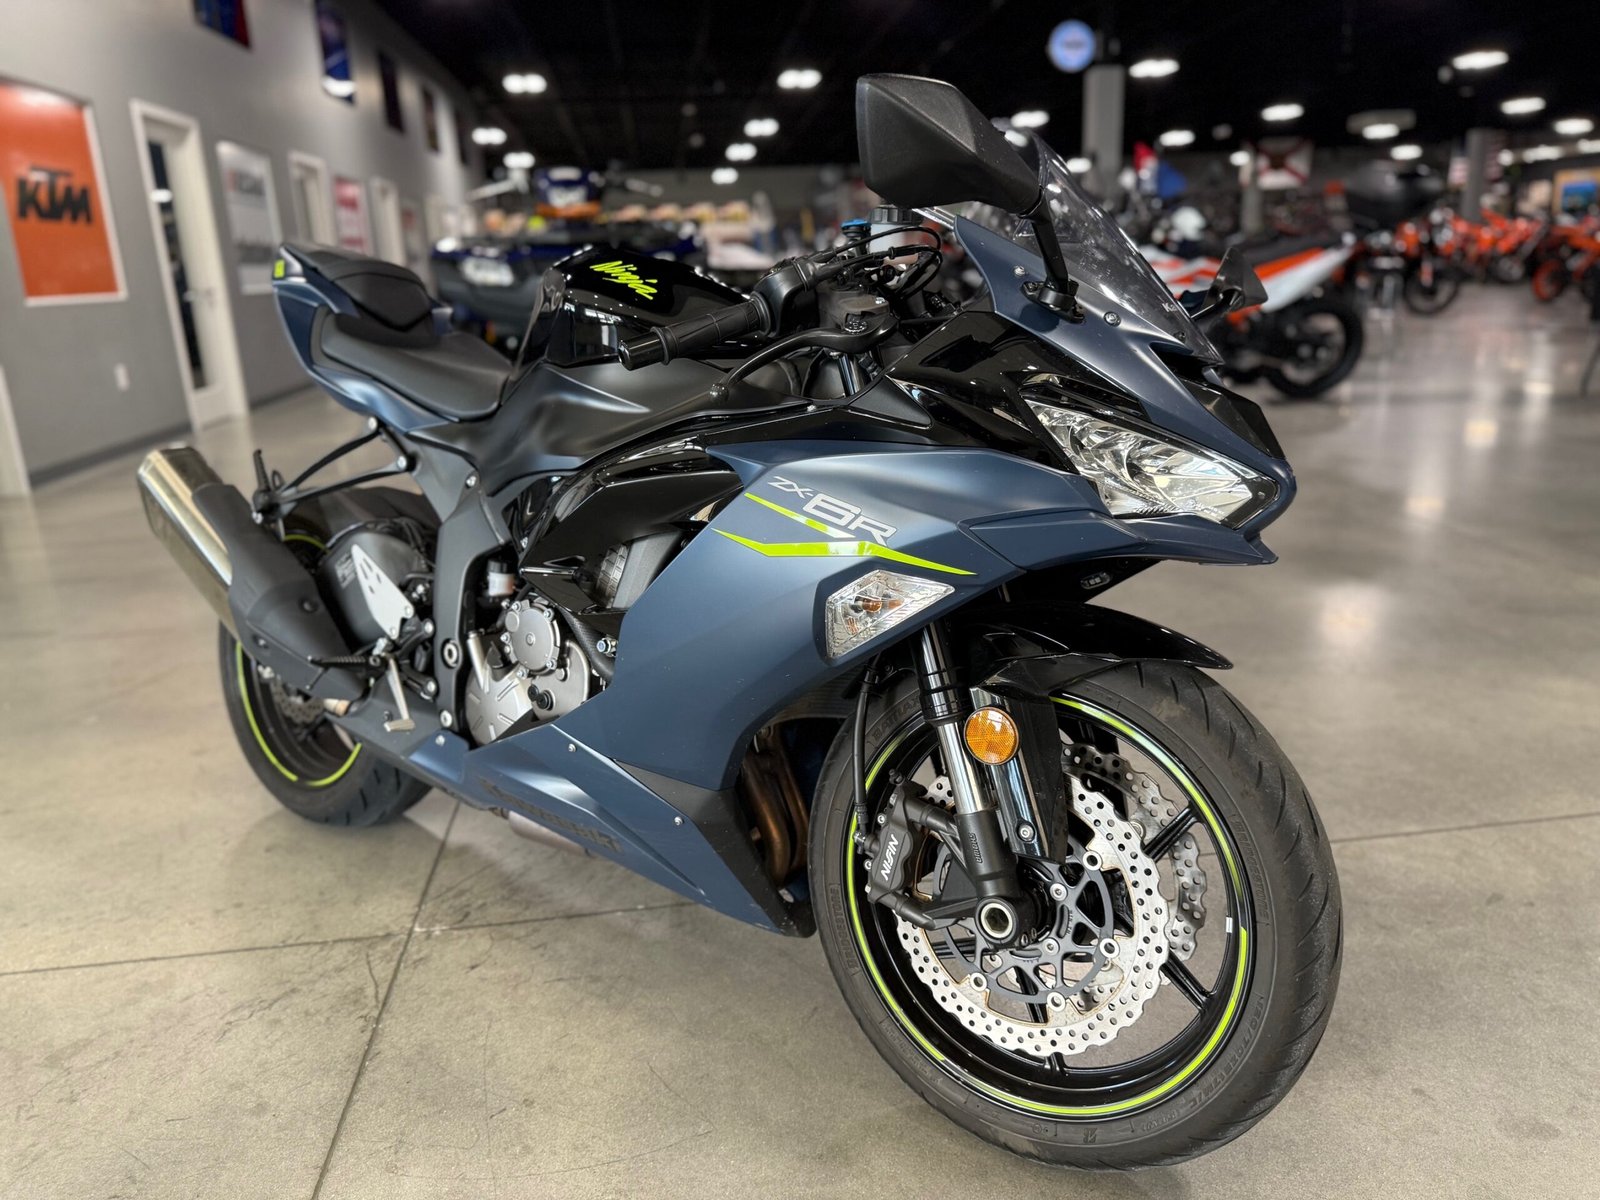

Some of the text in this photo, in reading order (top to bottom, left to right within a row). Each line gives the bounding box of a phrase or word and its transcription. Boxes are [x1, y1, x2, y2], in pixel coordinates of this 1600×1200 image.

[17, 163, 94, 224] KTM
[589, 260, 658, 300] Ninja
[767, 475, 897, 547] ZX-6R
